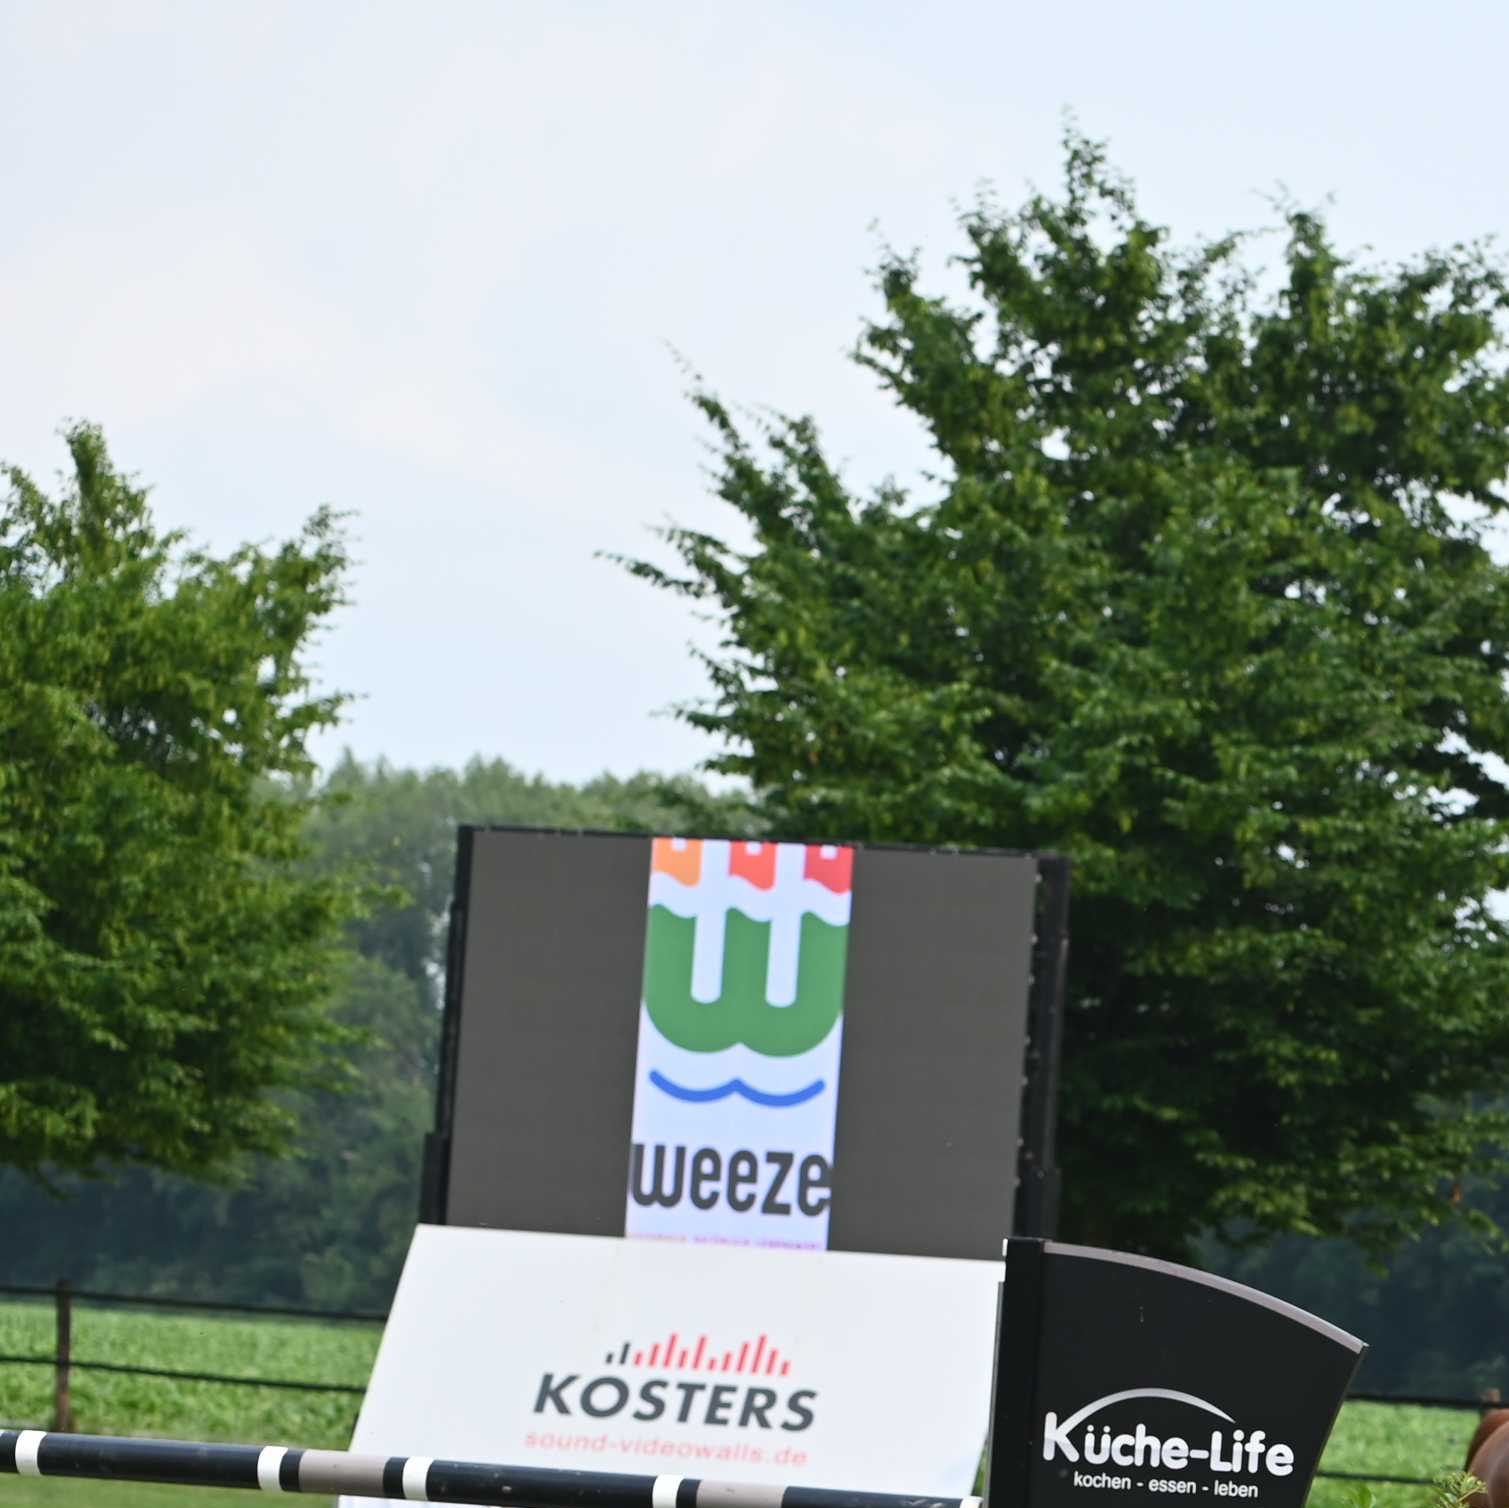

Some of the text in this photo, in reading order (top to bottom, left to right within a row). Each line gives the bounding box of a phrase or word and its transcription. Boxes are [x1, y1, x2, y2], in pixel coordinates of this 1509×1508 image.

[632, 1143, 832, 1217] weeze
[533, 1373, 817, 1431] KOSTERS
[525, 1432, 809, 1466] sound-videowalls.de
[1043, 1411, 1295, 1477] Küche-Life
[1073, 1470, 1132, 1490] kochen
[1148, 1478, 1197, 1494] essen
[1213, 1480, 1259, 1498] leben
